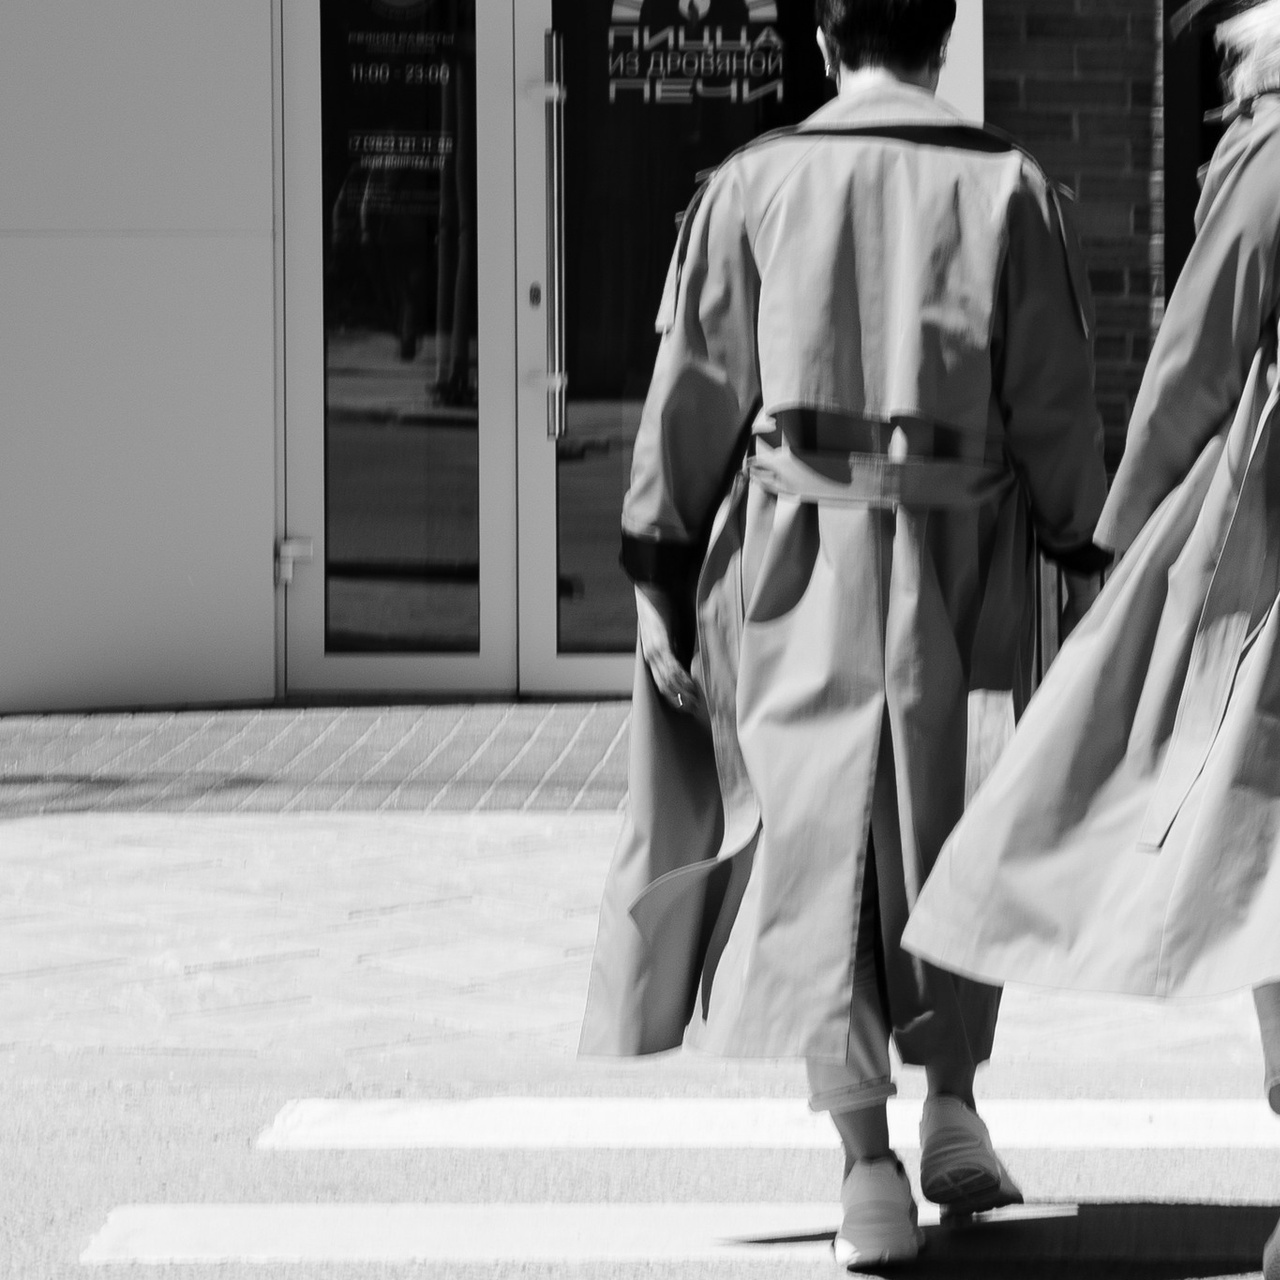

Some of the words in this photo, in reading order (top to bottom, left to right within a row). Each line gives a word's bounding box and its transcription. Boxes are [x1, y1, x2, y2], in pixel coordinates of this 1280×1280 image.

[607, 24, 784, 54] ПИЦЦА
[350, 63, 390, 85] 11:00
[405, 63, 450, 86] 23:00
[608, 50, 640, 78] ИЗ
[646, 49, 784, 80] ДРОВЯНОЙ
[608, 77, 784, 105] ПЕЧИ
